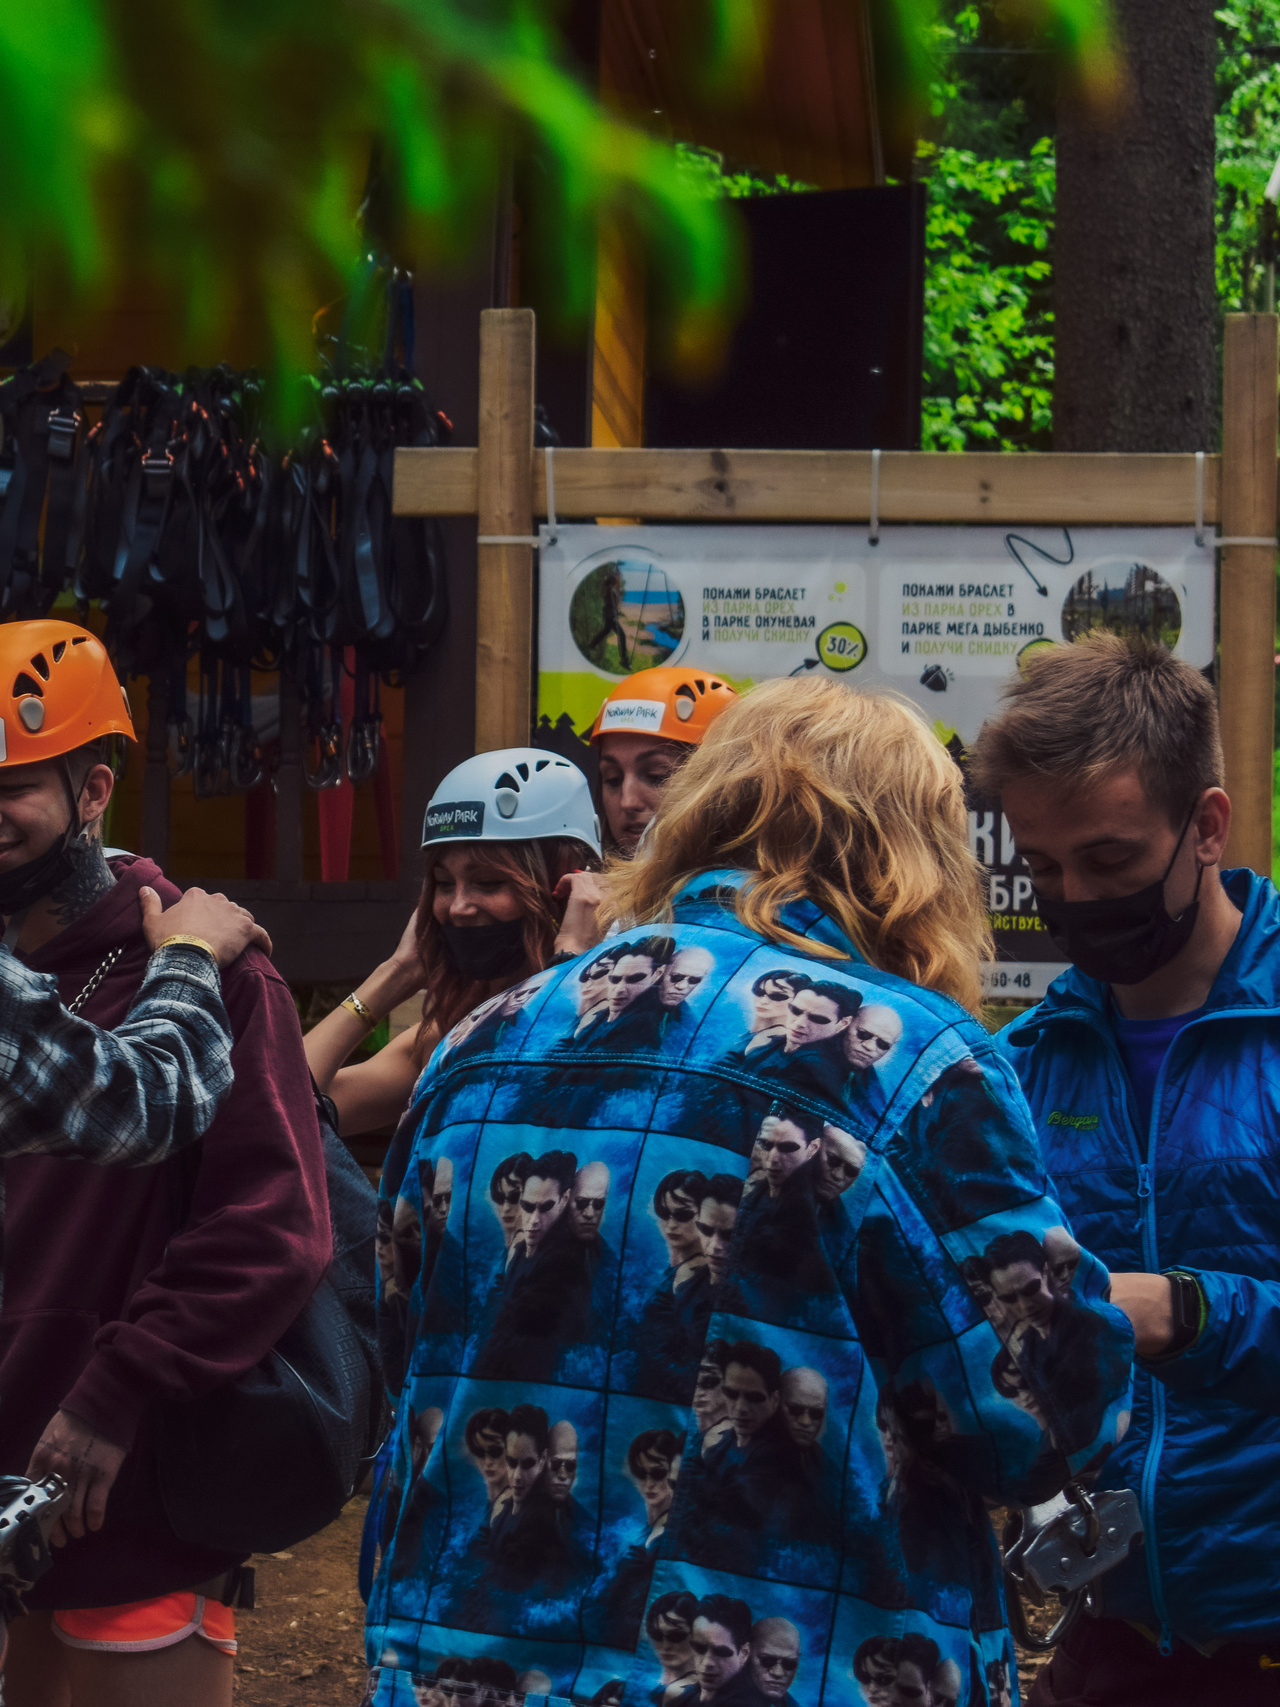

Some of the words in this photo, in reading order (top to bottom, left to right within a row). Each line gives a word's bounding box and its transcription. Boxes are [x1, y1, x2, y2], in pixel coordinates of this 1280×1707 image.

[703, 587, 750, 600] ПОКАЖИ
[755, 587, 806, 600] БРАСЛЕТ
[902, 583, 954, 597] ПОКАЖИ
[959, 583, 1014, 597] БРАСЛЕТ
[702, 602, 719, 614] ИЗ
[723, 602, 760, 614] ПАРКА
[764, 602, 795, 614] ОРЕХ
[902, 603, 919, 616] ИЗ
[924, 603, 964, 616] ПАРКА
[969, 603, 1002, 616] ОРЕХ
[1007, 603, 1015, 616] В
[702, 616, 710, 628] В
[714, 616, 750, 628] ПАРКЕ
[755, 616, 815, 628] ОКУНЕВАЯ
[901, 622, 941, 635] ПАРКЕ
[946, 622, 979, 635] МЕГА
[983, 622, 1044, 636] ДЫБЕНКО
[702, 629, 710, 641] И
[714, 629, 759, 642] ПОЛУЧИ
[764, 629, 810, 643] СКИДКУ
[826, 635, 859, 658] 30%
[901, 641, 910, 654] И
[914, 641, 963, 655] ПОЛУЧИ
[968, 641, 1018, 655] СКИДКУ
[636, 706, 657, 719] PARK
[454, 809, 478, 823] PARK
